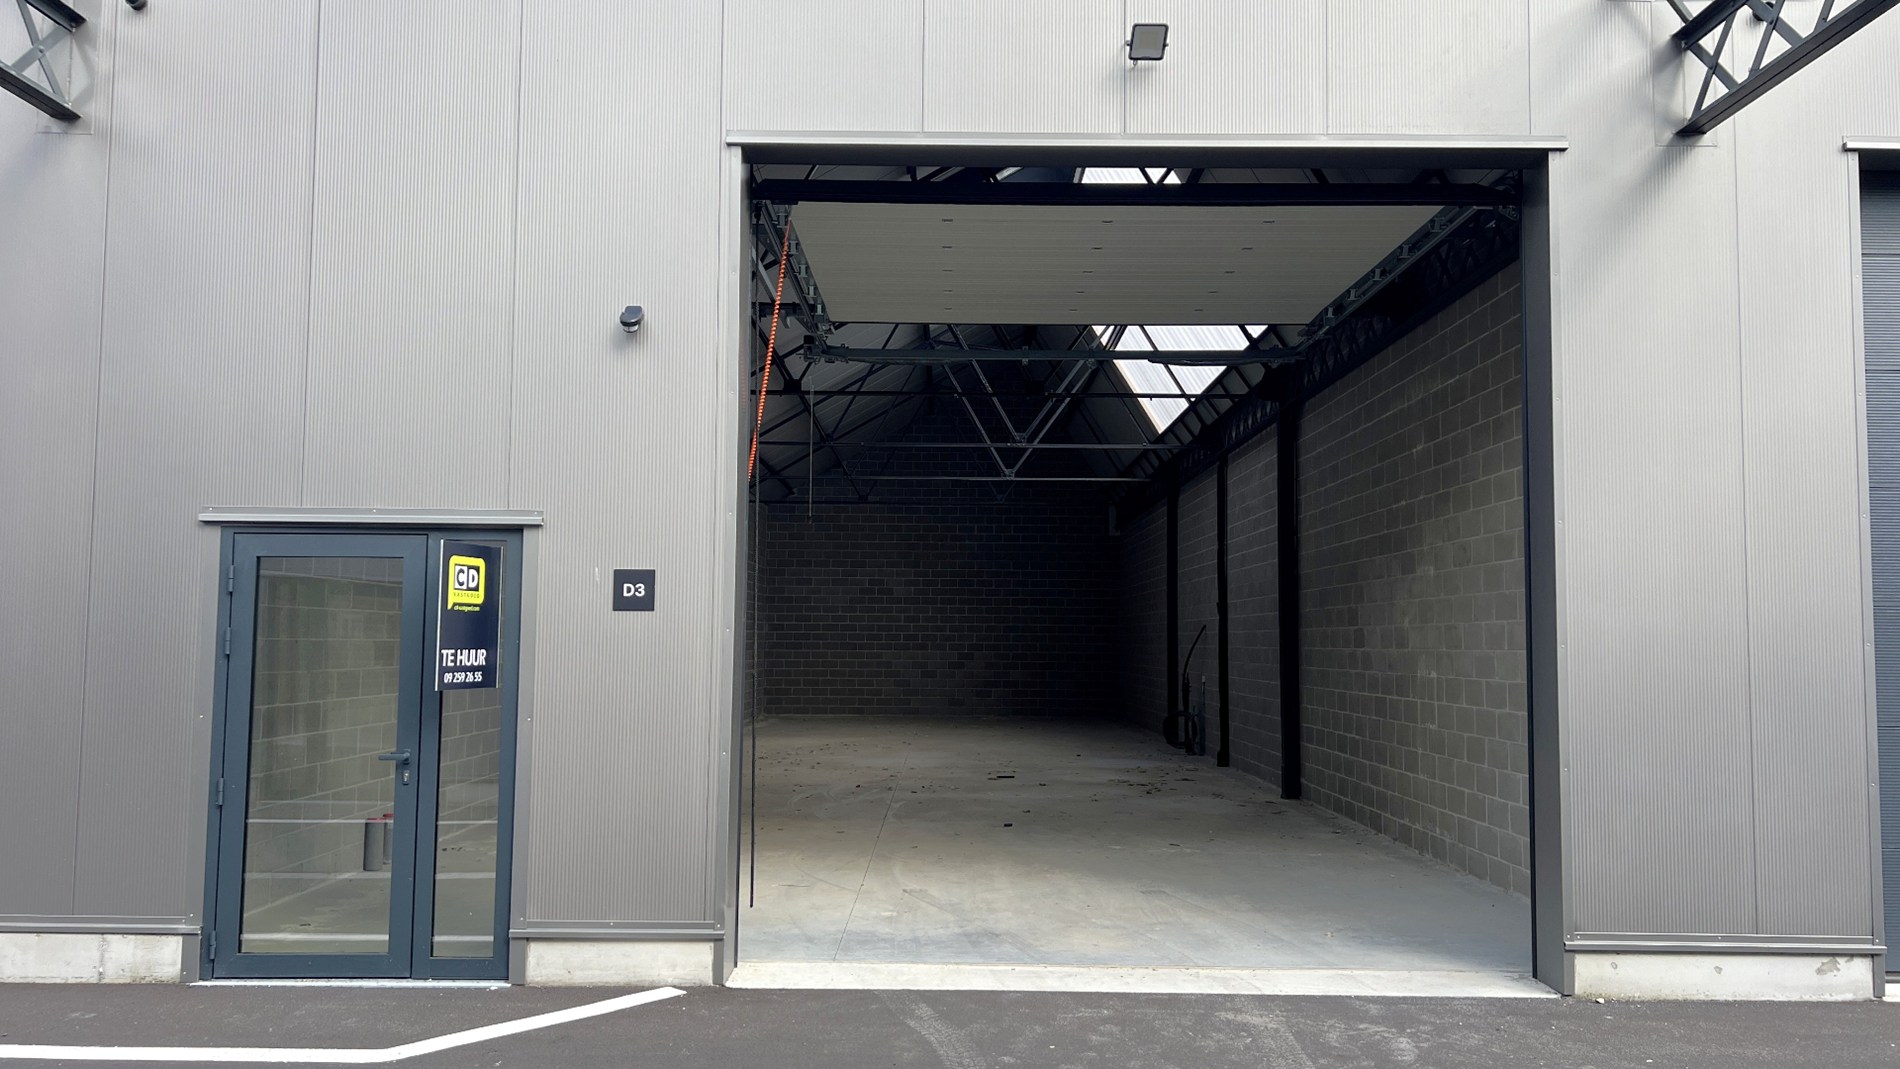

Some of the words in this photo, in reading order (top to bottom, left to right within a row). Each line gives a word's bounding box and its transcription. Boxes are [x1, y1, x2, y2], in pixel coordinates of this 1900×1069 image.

[456, 567, 479, 588] CD
[622, 583, 646, 597] D3
[441, 649, 455, 667] TE
[456, 649, 487, 666] HUUR
[443, 672, 453, 684] 09
[453, 672, 465, 683] 259
[465, 671, 474, 682] 26
[474, 671, 483, 682] 55
